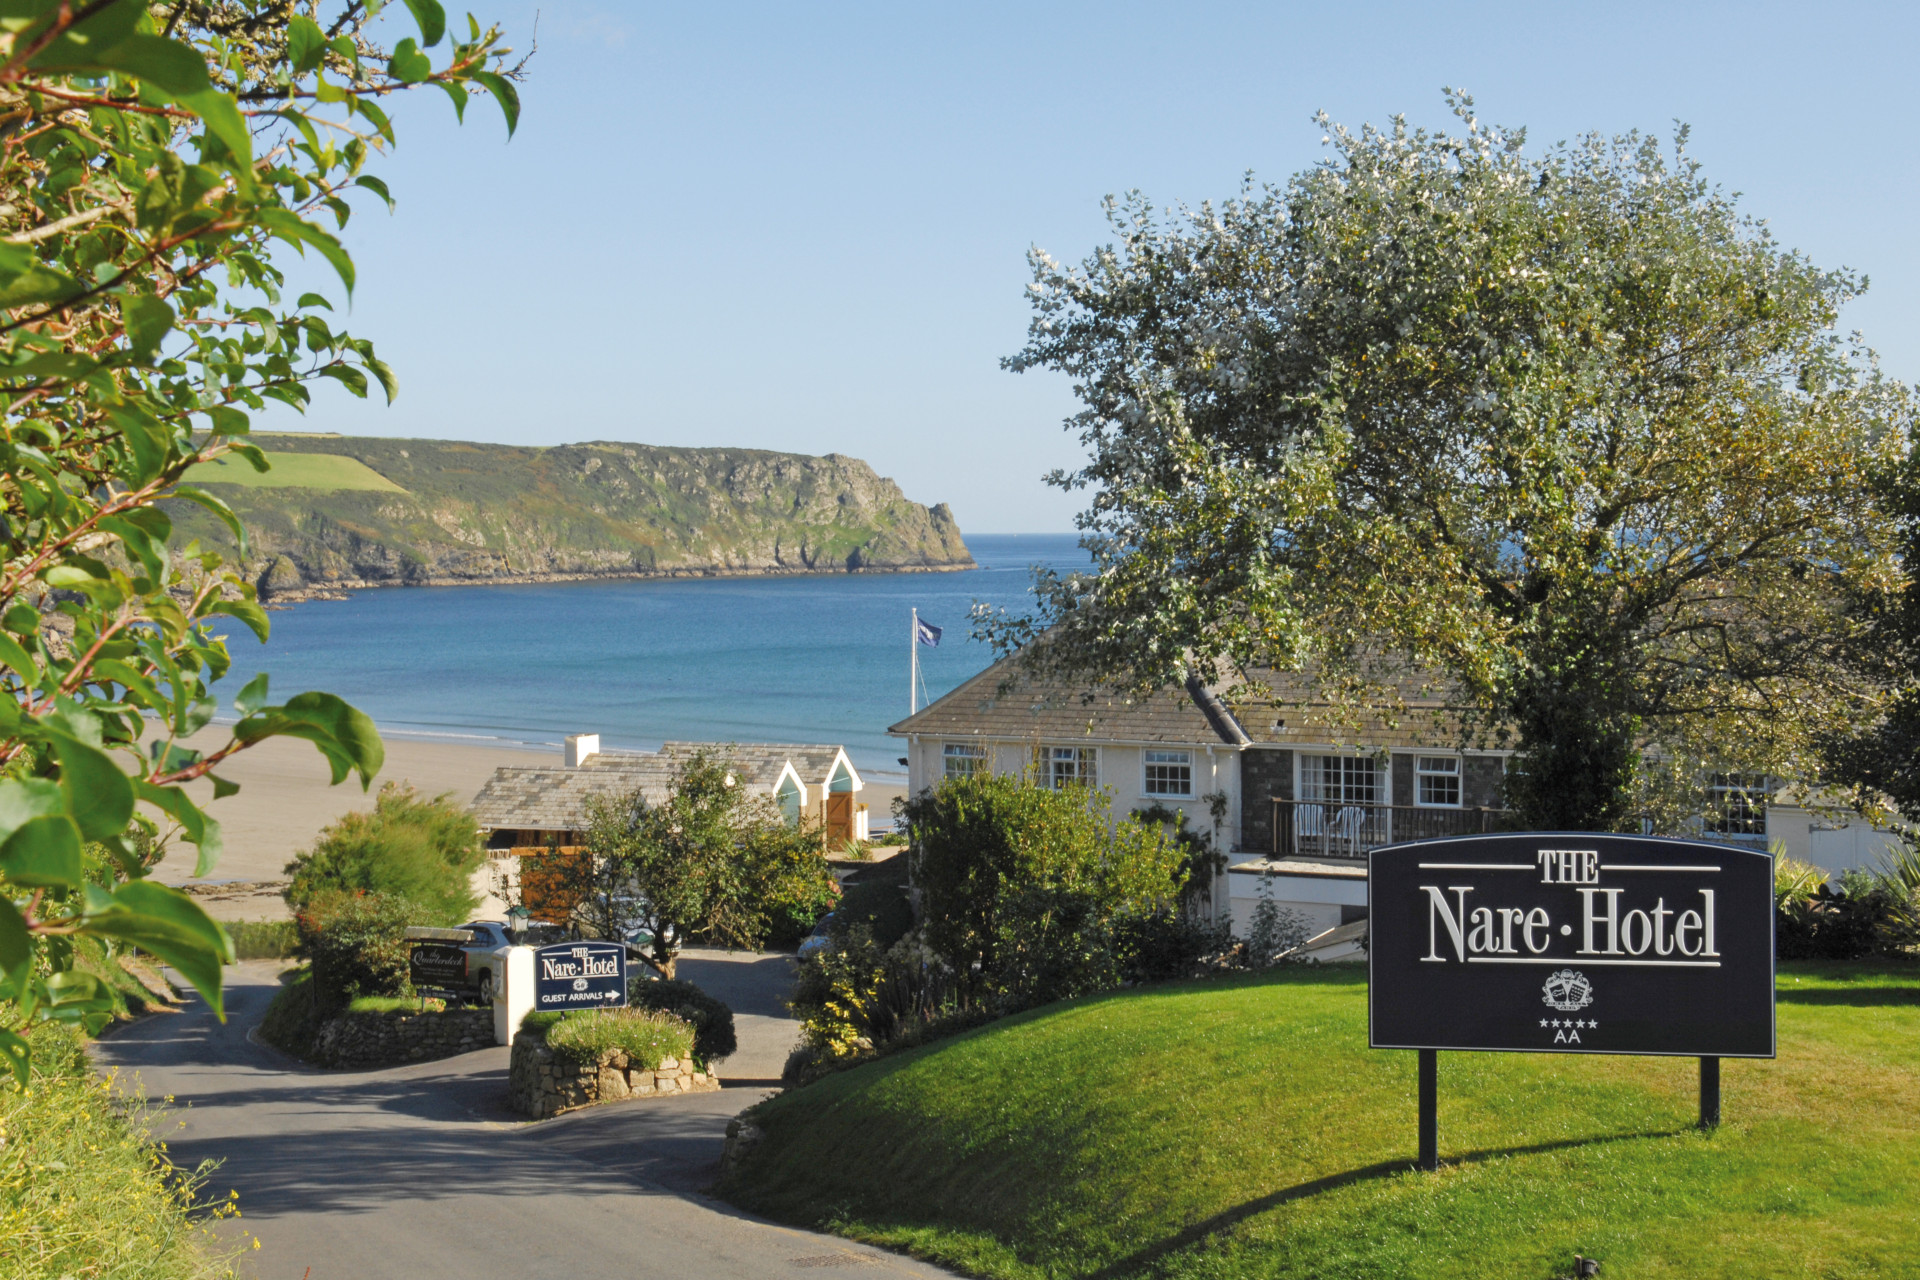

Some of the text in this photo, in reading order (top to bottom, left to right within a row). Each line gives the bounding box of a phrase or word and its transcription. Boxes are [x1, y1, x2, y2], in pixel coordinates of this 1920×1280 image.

[1538, 850, 1599, 884] THE
[1419, 886, 1721, 963] Nare Hotel
[411, 951, 463, 965] Quarterdeck
[572, 947, 588, 957] THE
[542, 956, 618, 980] Nare Hotel
[542, 992, 603, 1003] GUEST ARRIVALS
[1554, 1029, 1581, 1044] AA
